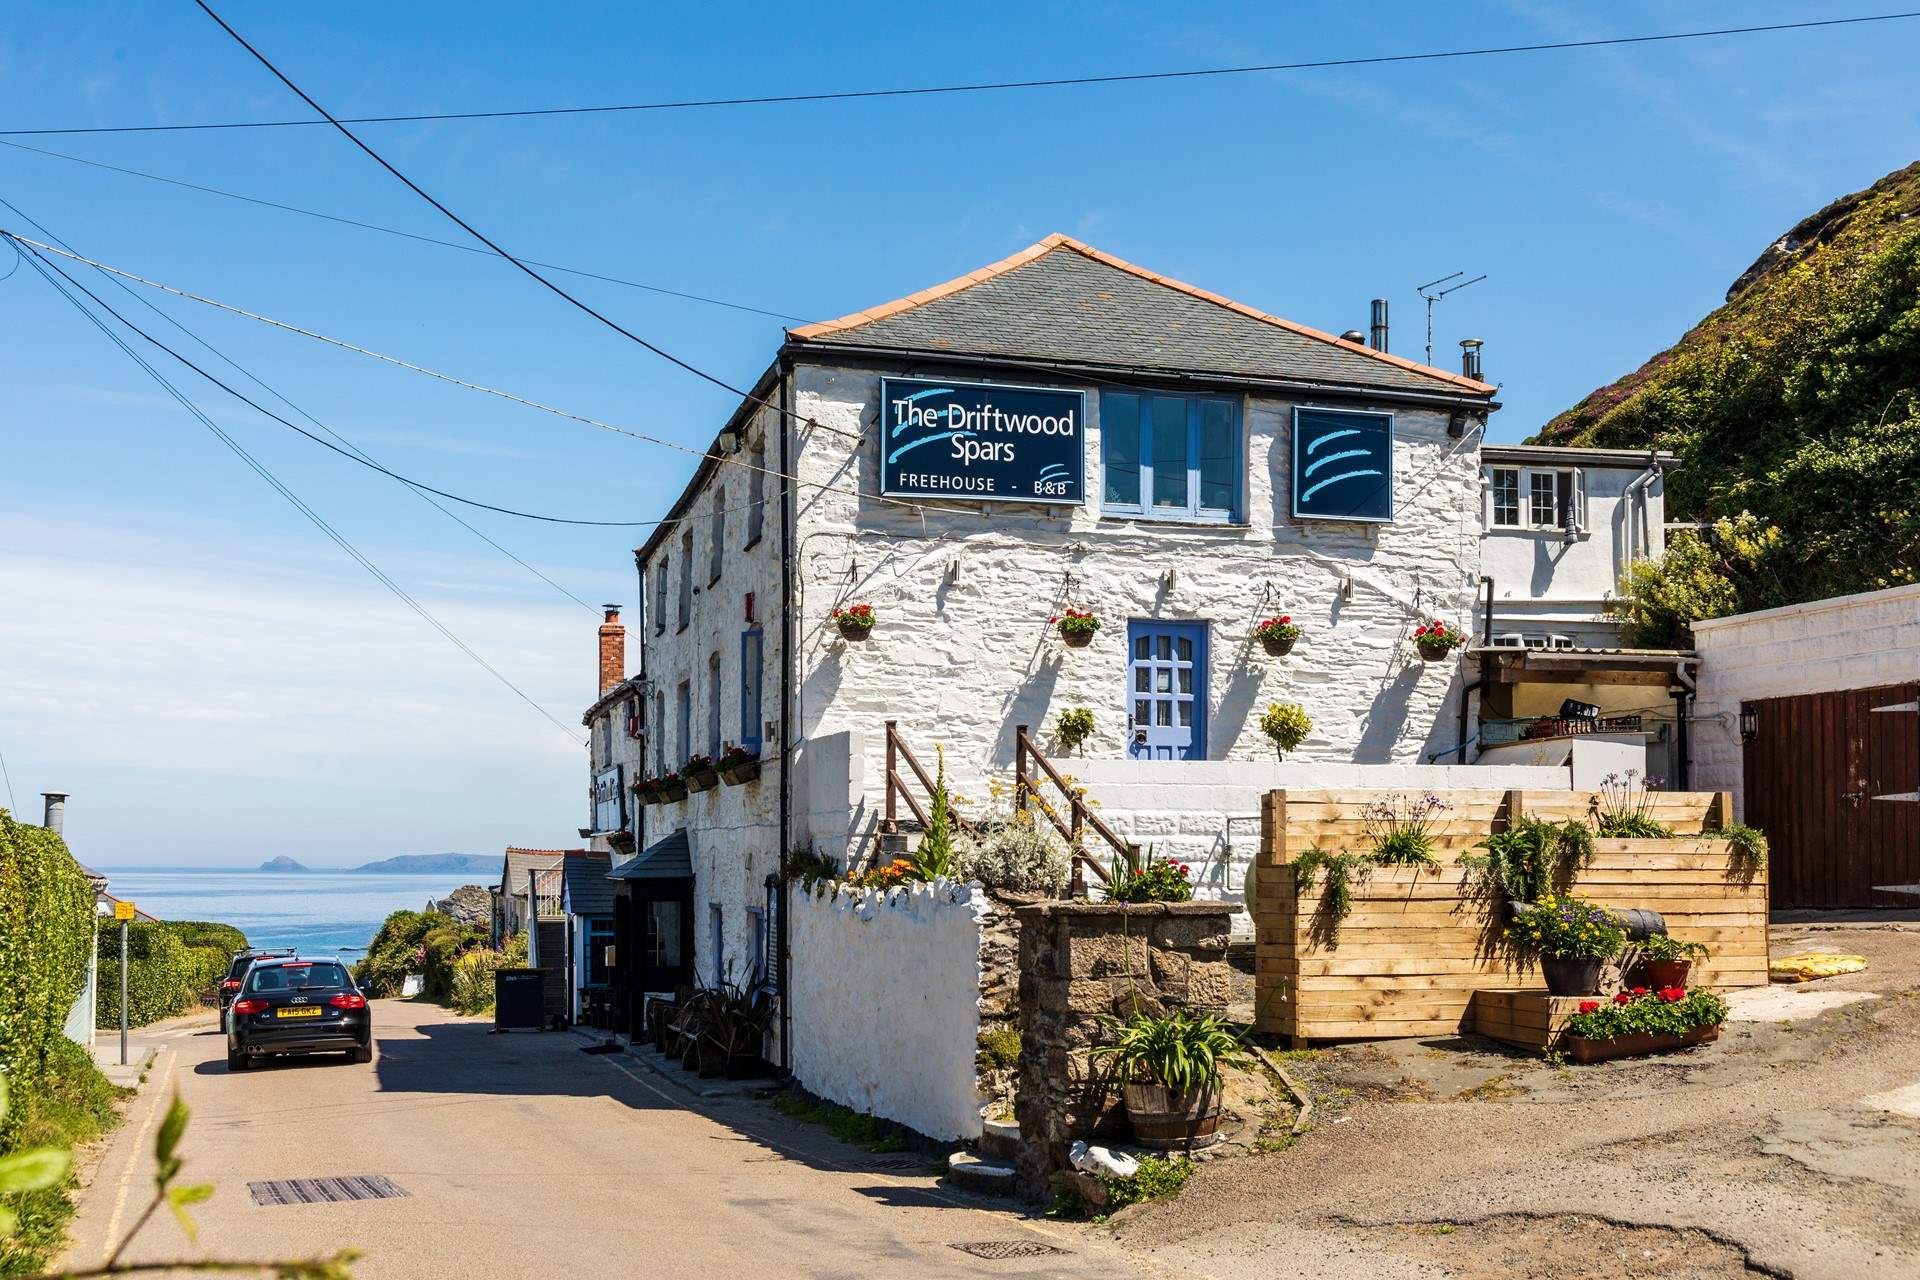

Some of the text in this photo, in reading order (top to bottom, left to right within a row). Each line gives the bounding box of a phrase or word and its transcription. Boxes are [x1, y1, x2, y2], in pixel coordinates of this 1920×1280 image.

[892, 399, 1074, 437] The Driftwood
[951, 433, 1015, 466] Spars
[899, 473, 995, 492] FREEHOUSE
[1034, 481, 1066, 496] B&B
